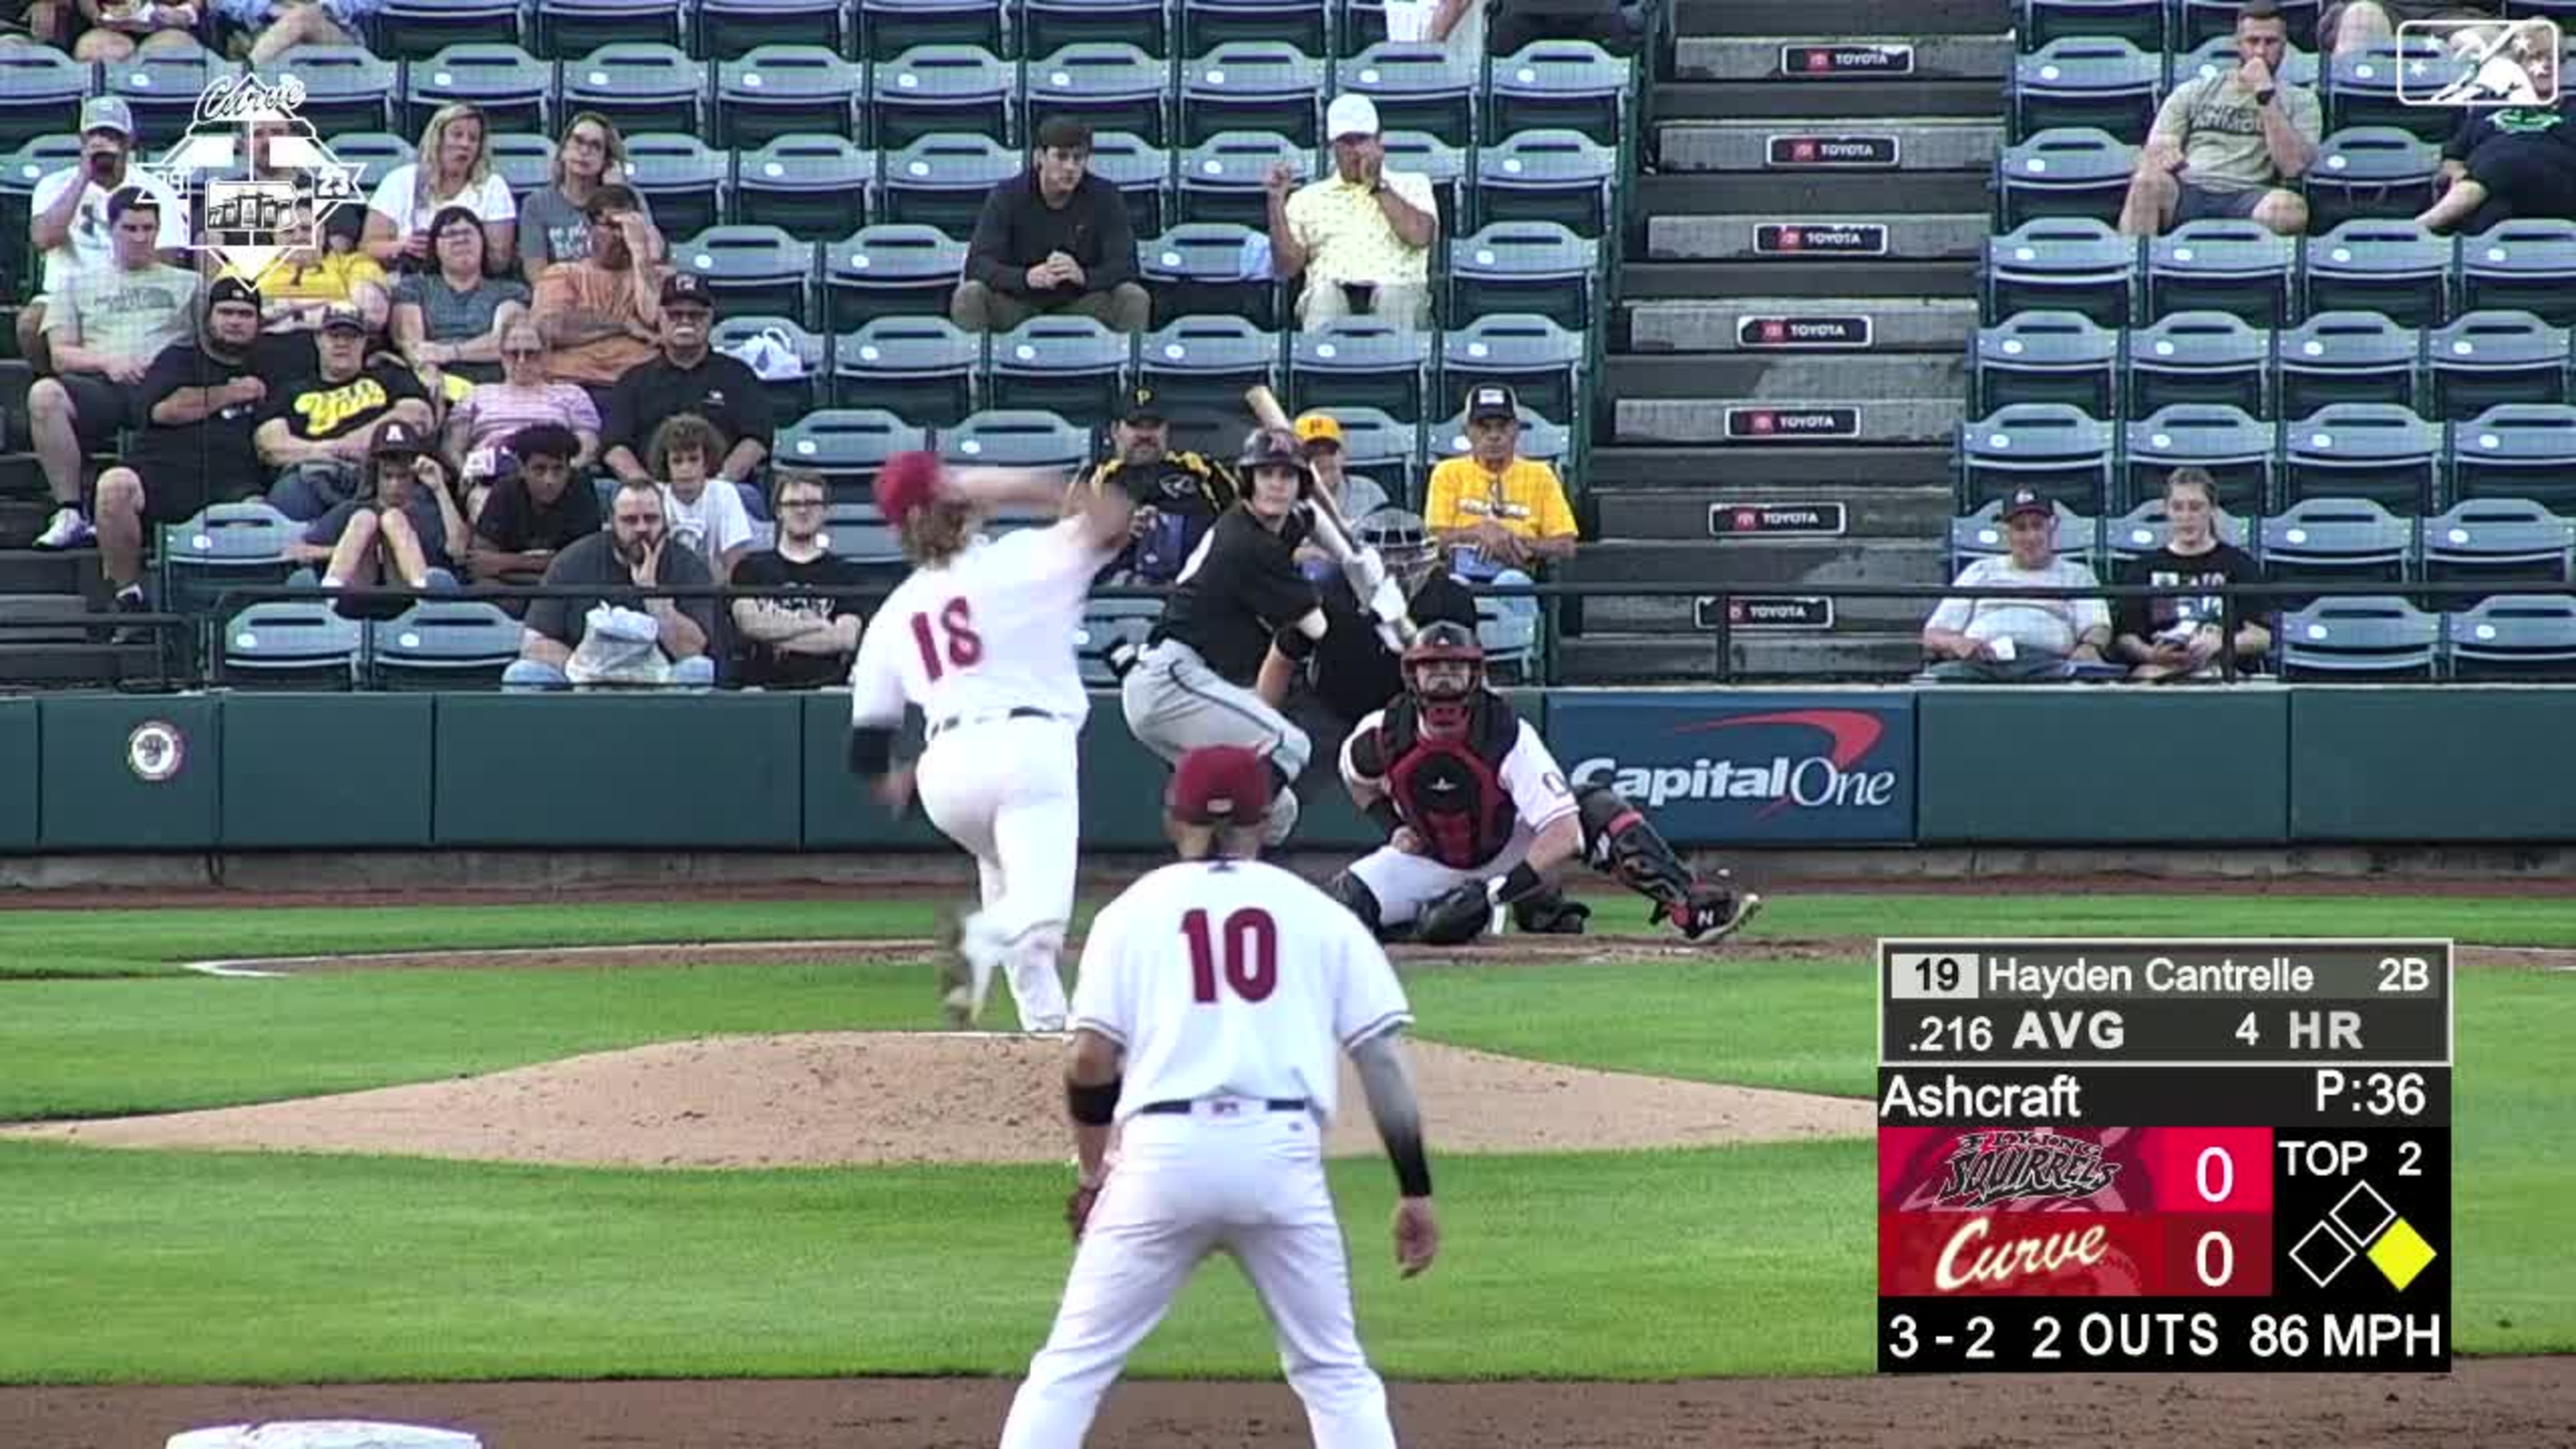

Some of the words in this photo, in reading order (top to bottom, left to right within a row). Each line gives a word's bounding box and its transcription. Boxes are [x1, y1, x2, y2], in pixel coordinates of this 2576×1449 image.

[1835, 54, 1888, 65] TOYOTA
[1820, 144, 1874, 156] TOYOTA
[1806, 233, 1860, 244] TOYOTA
[1790, 324, 1845, 337] TOYOTA
[1137, 390, 1150, 406] P
[1779, 415, 1835, 428] TOYOTA
[386, 425, 404, 441] A
[1762, 512, 1819, 524] TOYOTA
[1749, 605, 1806, 618] TOYOTA
[911, 595, 983, 682] 18
[1178, 907, 1278, 1004] 10
